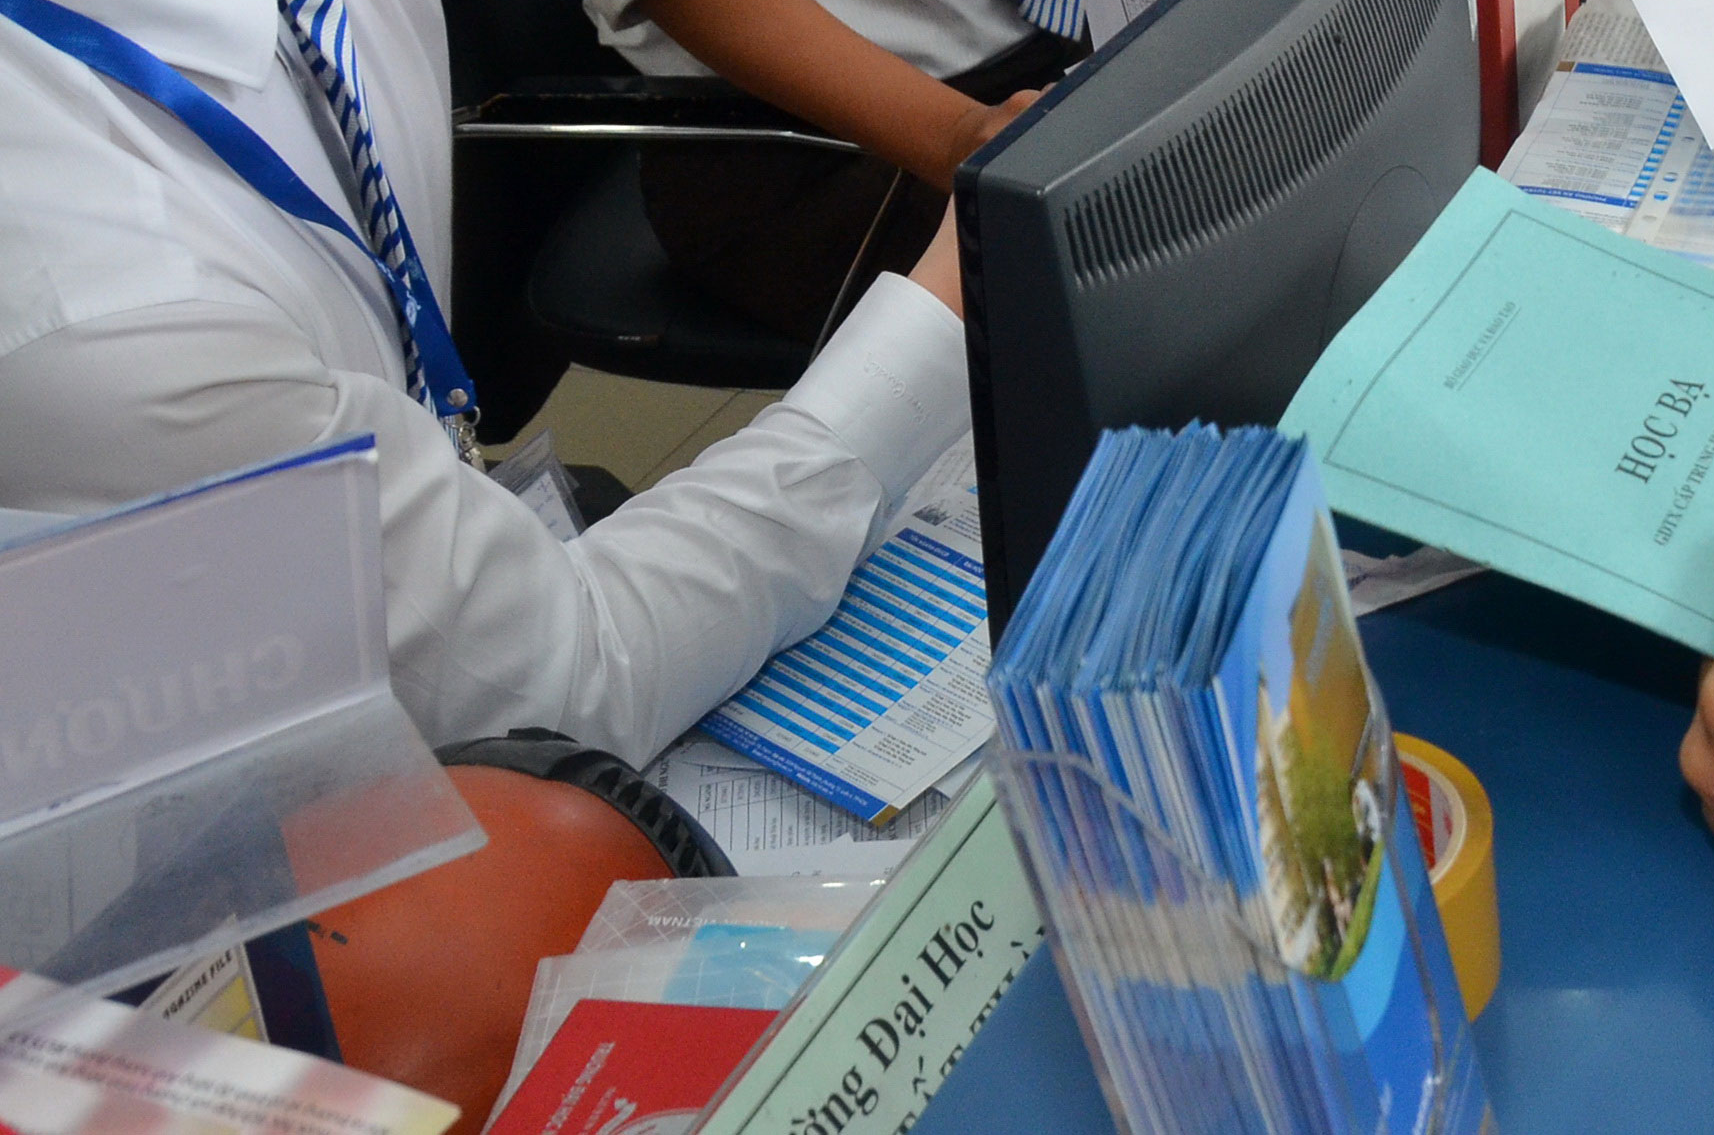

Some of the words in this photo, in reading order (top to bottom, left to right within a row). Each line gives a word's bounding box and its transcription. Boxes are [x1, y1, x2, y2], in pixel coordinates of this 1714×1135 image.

[1615, 412, 1679, 483] HỌC
[1658, 379, 1709, 415] BẠ
[790, 1065, 879, 1135] ờng
[855, 974, 934, 1072] Đại
[916, 900, 996, 992] Học
